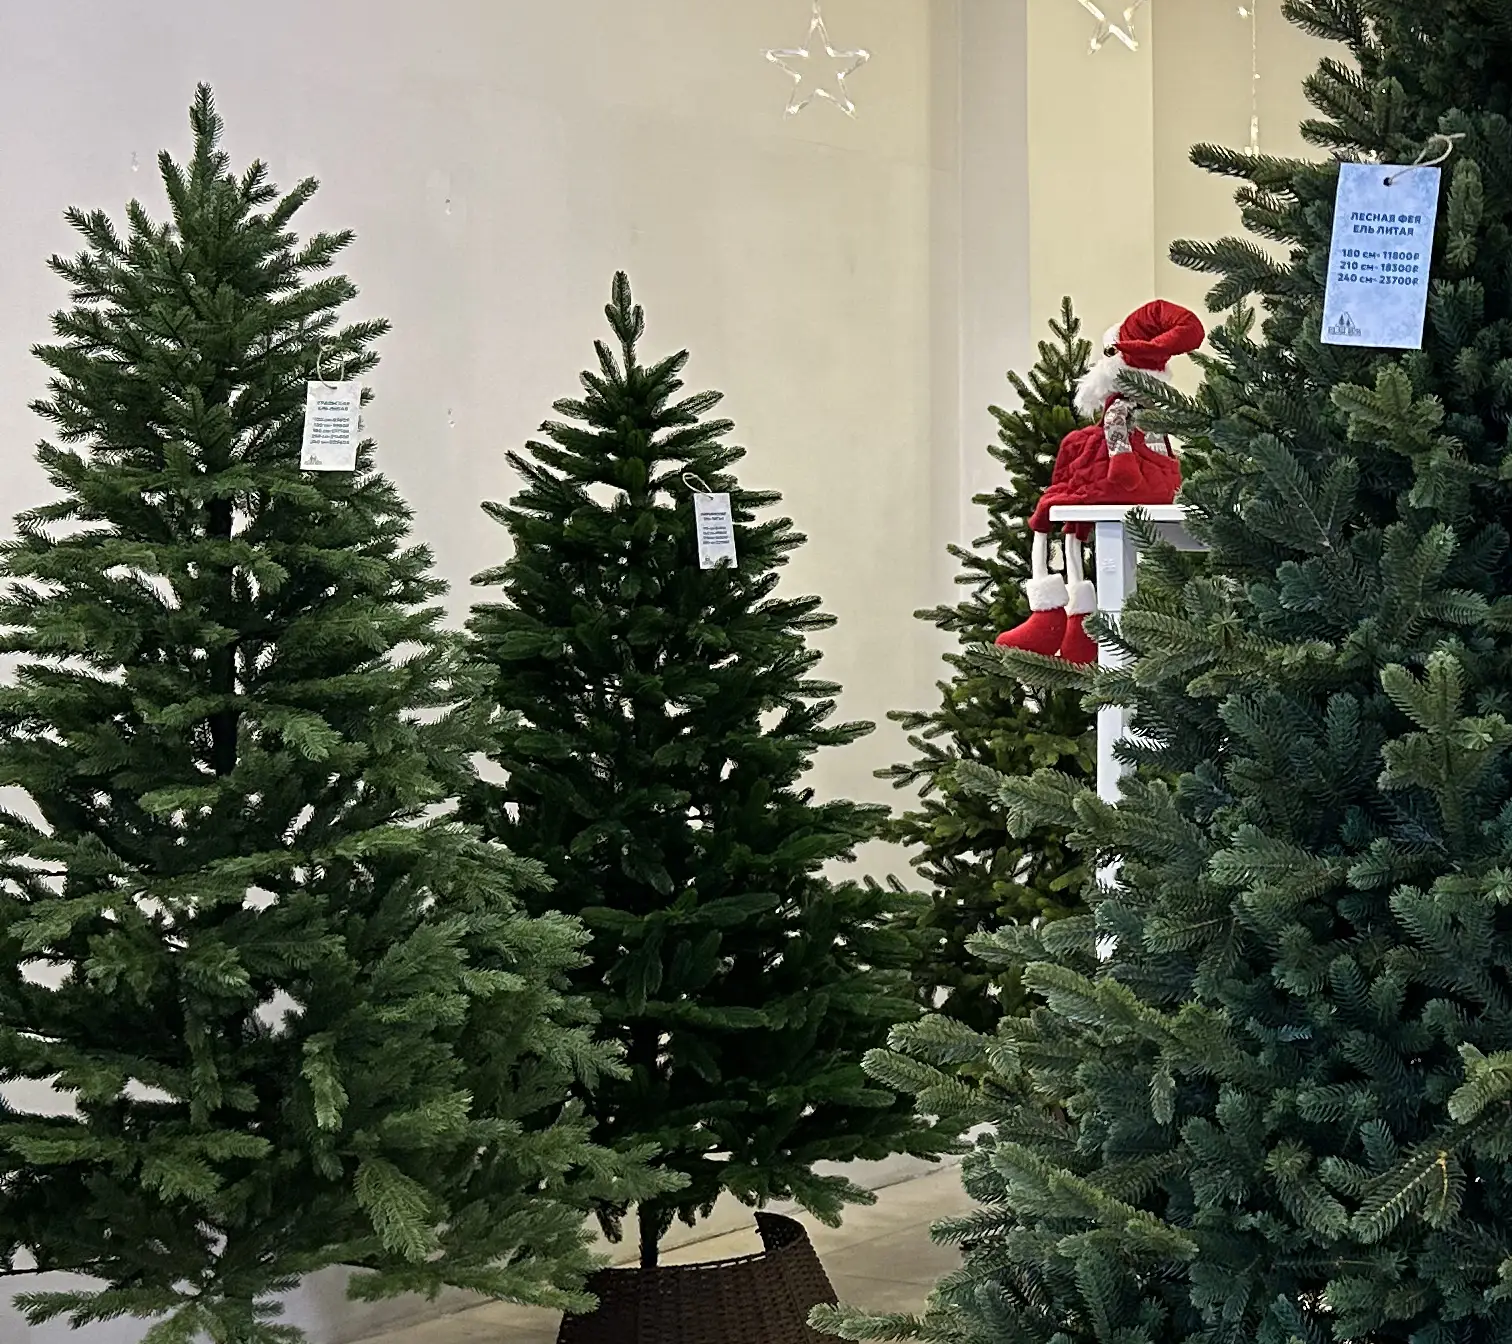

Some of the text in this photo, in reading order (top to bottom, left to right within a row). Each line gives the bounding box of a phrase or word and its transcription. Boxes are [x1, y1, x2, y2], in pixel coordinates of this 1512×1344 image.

[1350, 212, 1422, 225] ЛЕСНАЯ ФЕЯ
[1353, 224, 1414, 236] ЕЛЬ ЛИТАЯ
[1342, 248, 1360, 258] 180
[1340, 260, 1358, 270] 210
[1337, 272, 1357, 282] 240
